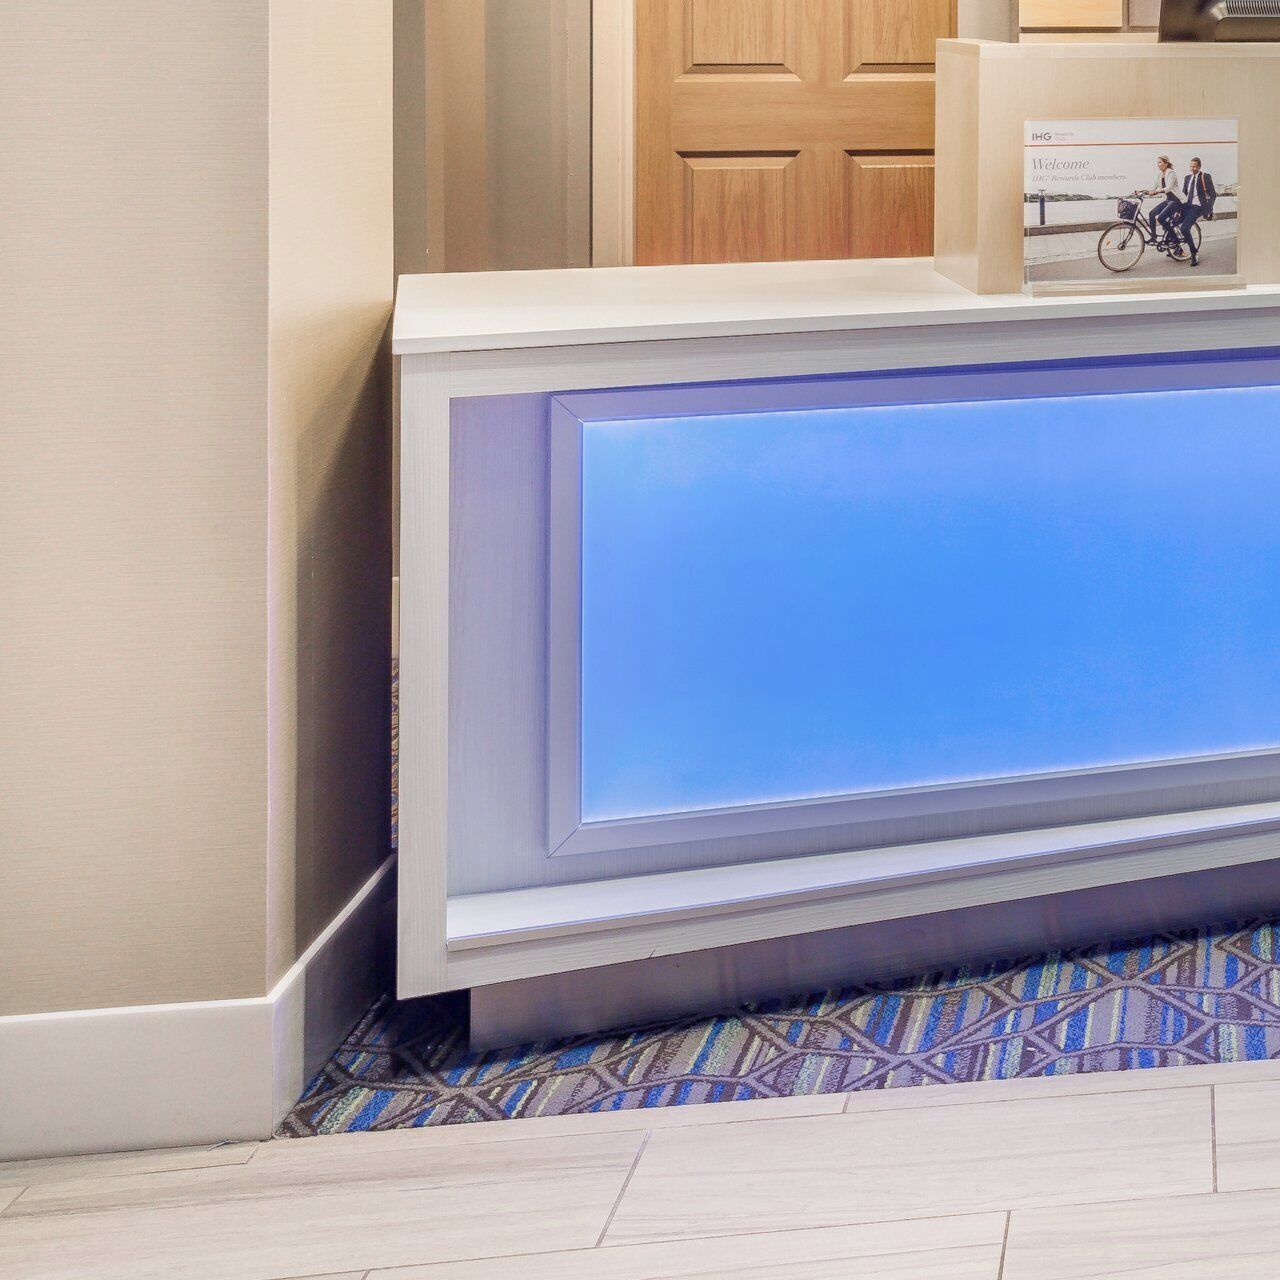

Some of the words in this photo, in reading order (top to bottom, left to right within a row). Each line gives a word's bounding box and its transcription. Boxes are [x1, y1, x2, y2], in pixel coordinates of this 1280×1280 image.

[1031, 132, 1052, 141] IHG
[1031, 158, 1090, 170] Welcome
[1051, 174, 1079, 182] Rewards
[1080, 173, 1097, 181] Club
[1097, 173, 1127, 181] members
